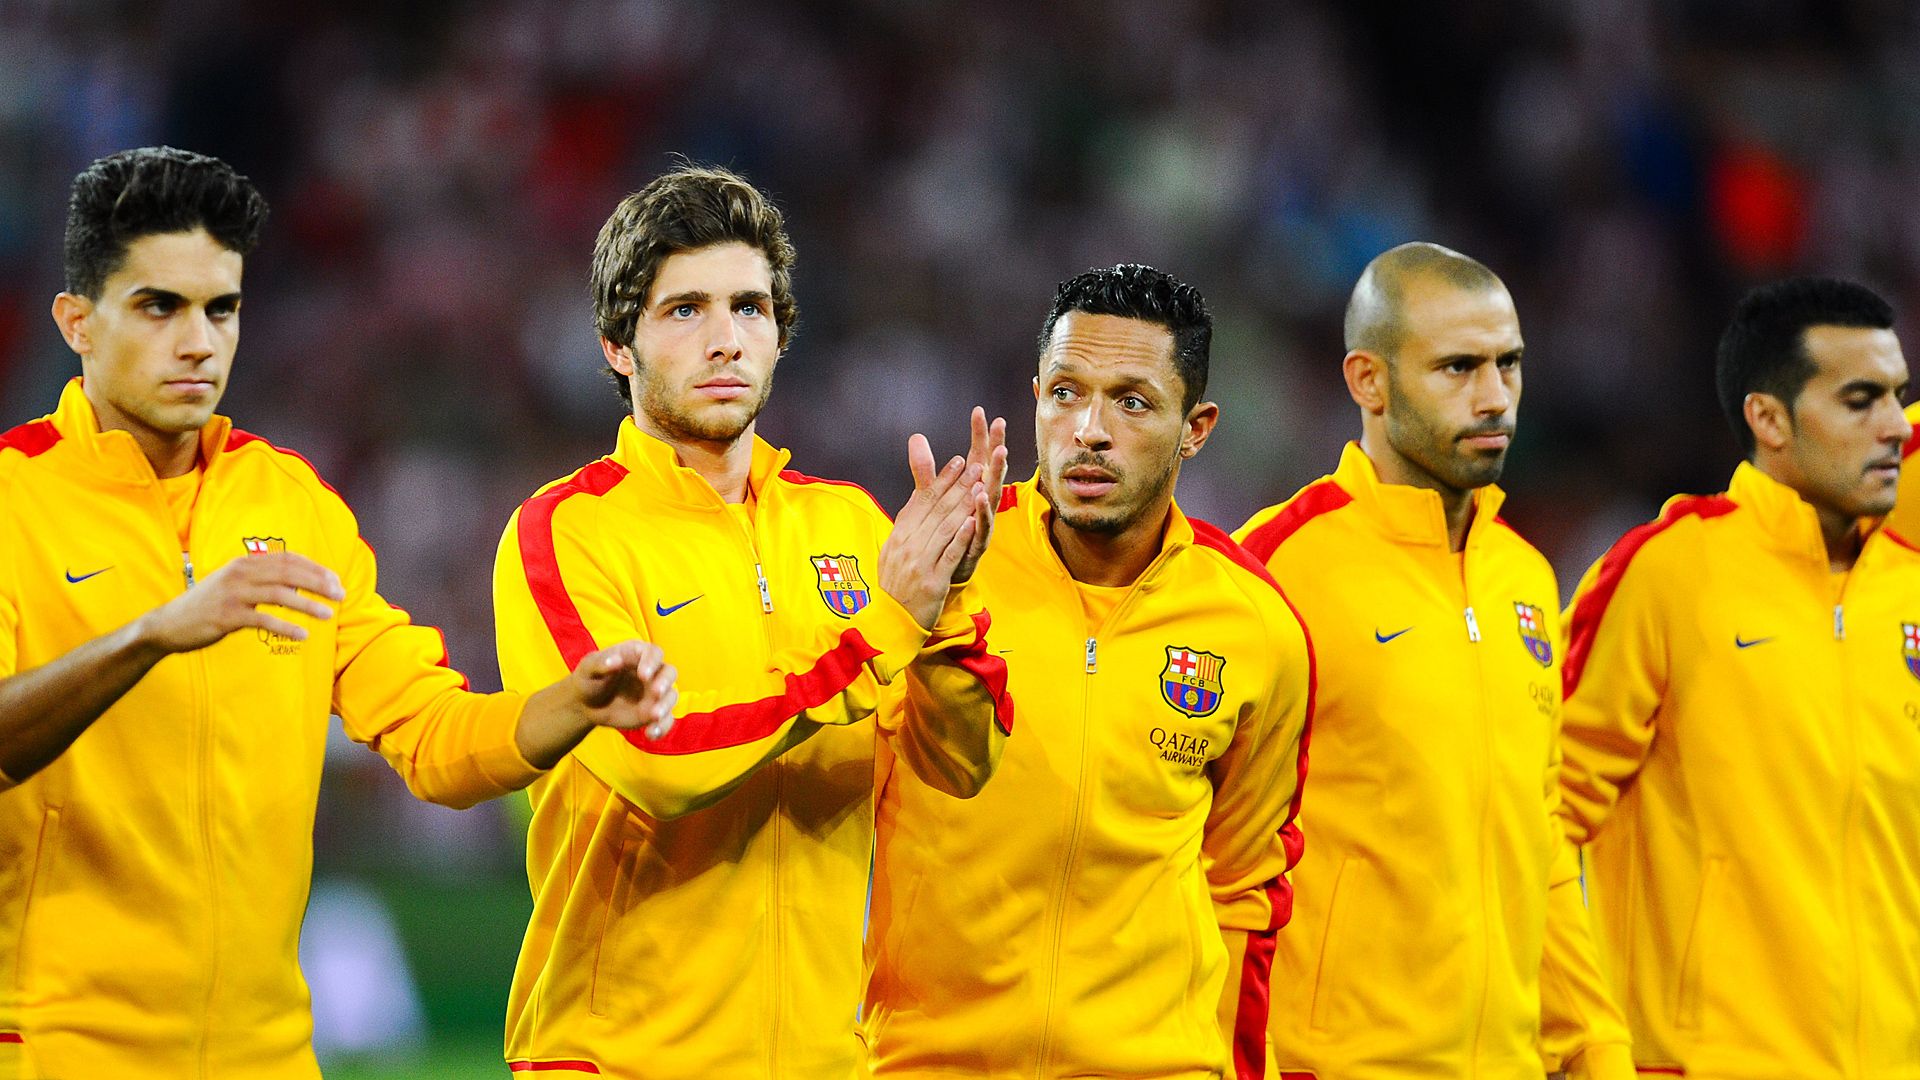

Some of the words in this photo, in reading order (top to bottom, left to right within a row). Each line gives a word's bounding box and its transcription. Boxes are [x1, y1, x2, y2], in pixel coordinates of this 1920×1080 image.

[1182, 675, 1205, 688] FCB
[1149, 727, 1209, 756] QATAR
[1160, 750, 1204, 767] AIRWAYS
